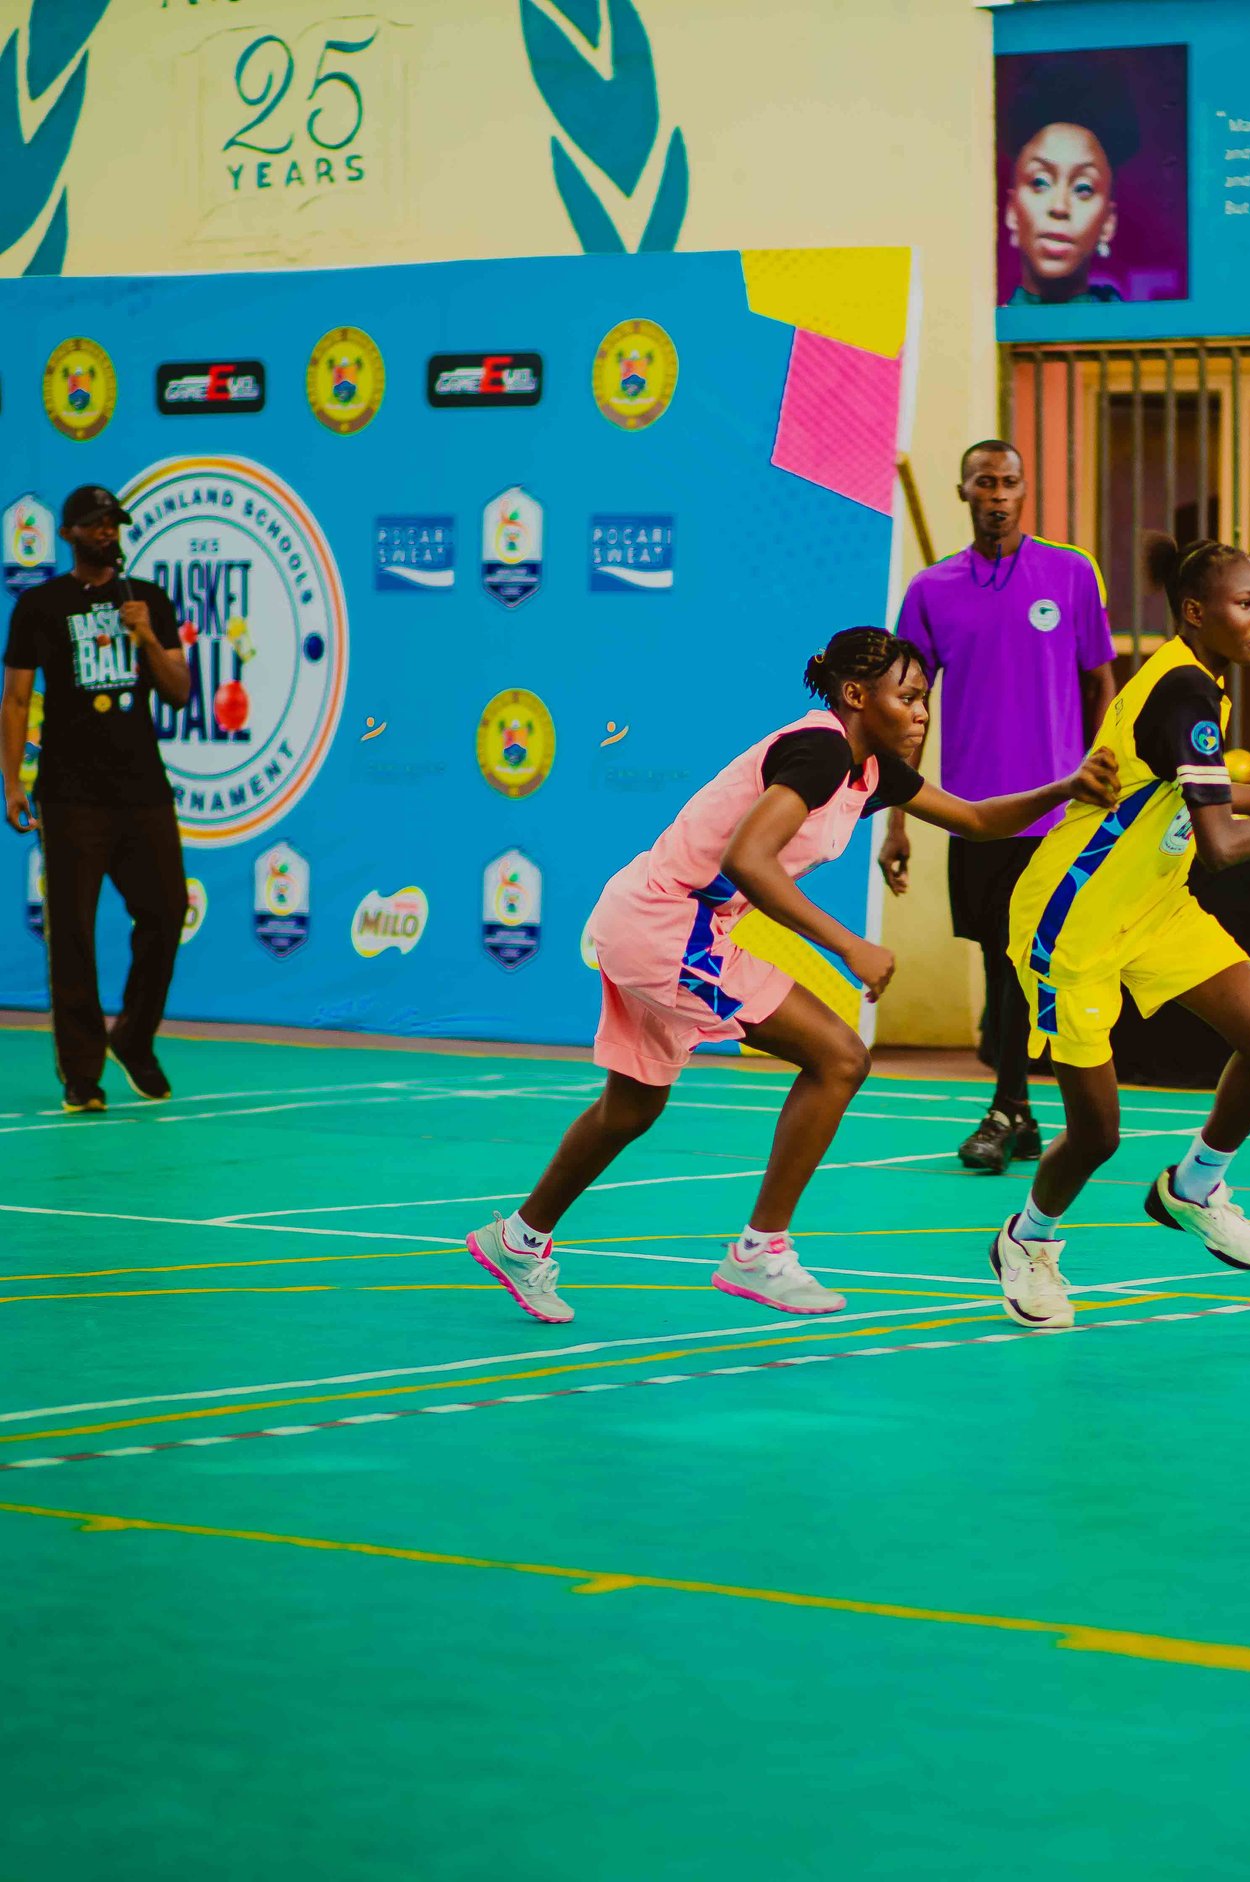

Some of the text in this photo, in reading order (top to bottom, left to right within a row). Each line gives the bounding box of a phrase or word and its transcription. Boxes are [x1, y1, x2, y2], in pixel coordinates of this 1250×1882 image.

[223, 24, 380, 155] 25
[227, 154, 365, 190] YEARS
[1224, 200, 1250, 215] But
[128, 488, 314, 605] MAINLAND SCHOOLS
[593, 527, 671, 545] POCARI
[594, 547, 663, 563] SWEAT
[174, 739, 293, 812] RNAMENT
[358, 909, 419, 938] MILO
